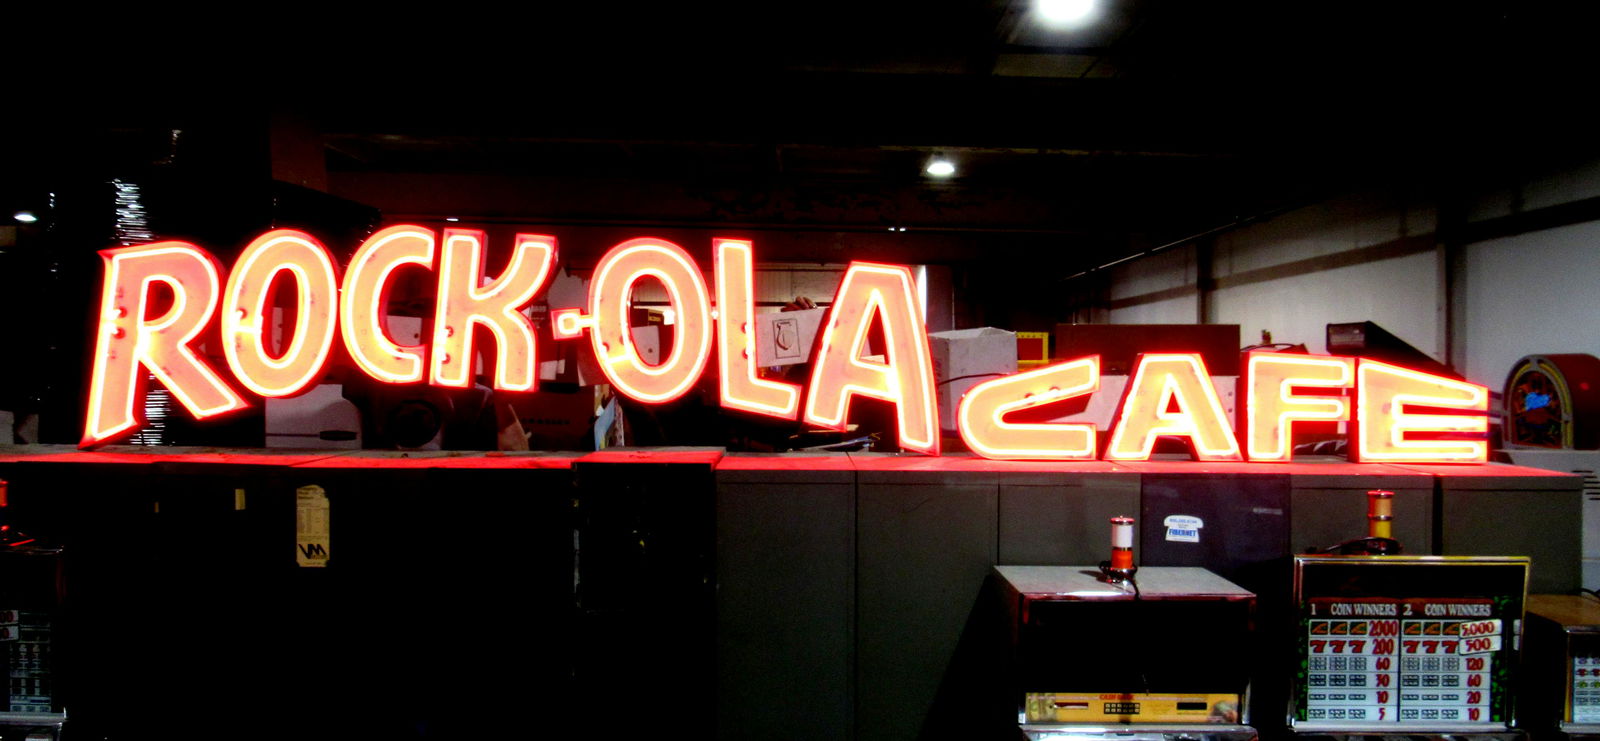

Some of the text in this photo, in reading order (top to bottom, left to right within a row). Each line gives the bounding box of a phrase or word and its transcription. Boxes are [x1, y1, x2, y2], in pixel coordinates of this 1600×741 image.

[79, 224, 1489, 463] ROCK-OLA CAFE
[1310, 603, 1397, 616] 1 COIN WINNERS
[1402, 603, 1492, 616] 2 COIN WINNERS
[1372, 638, 1395, 655] 200
[1465, 637, 1491, 654] 500
[1375, 657, 1391, 671] 60
[1465, 657, 1484, 671] 120
[1375, 674, 1390, 688] 30
[1467, 673, 1482, 688] 60
[1376, 691, 1389, 704] 10
[1466, 691, 1481, 705] 20
[1378, 707, 1386, 721] 5
[1466, 708, 1480, 721] 10
